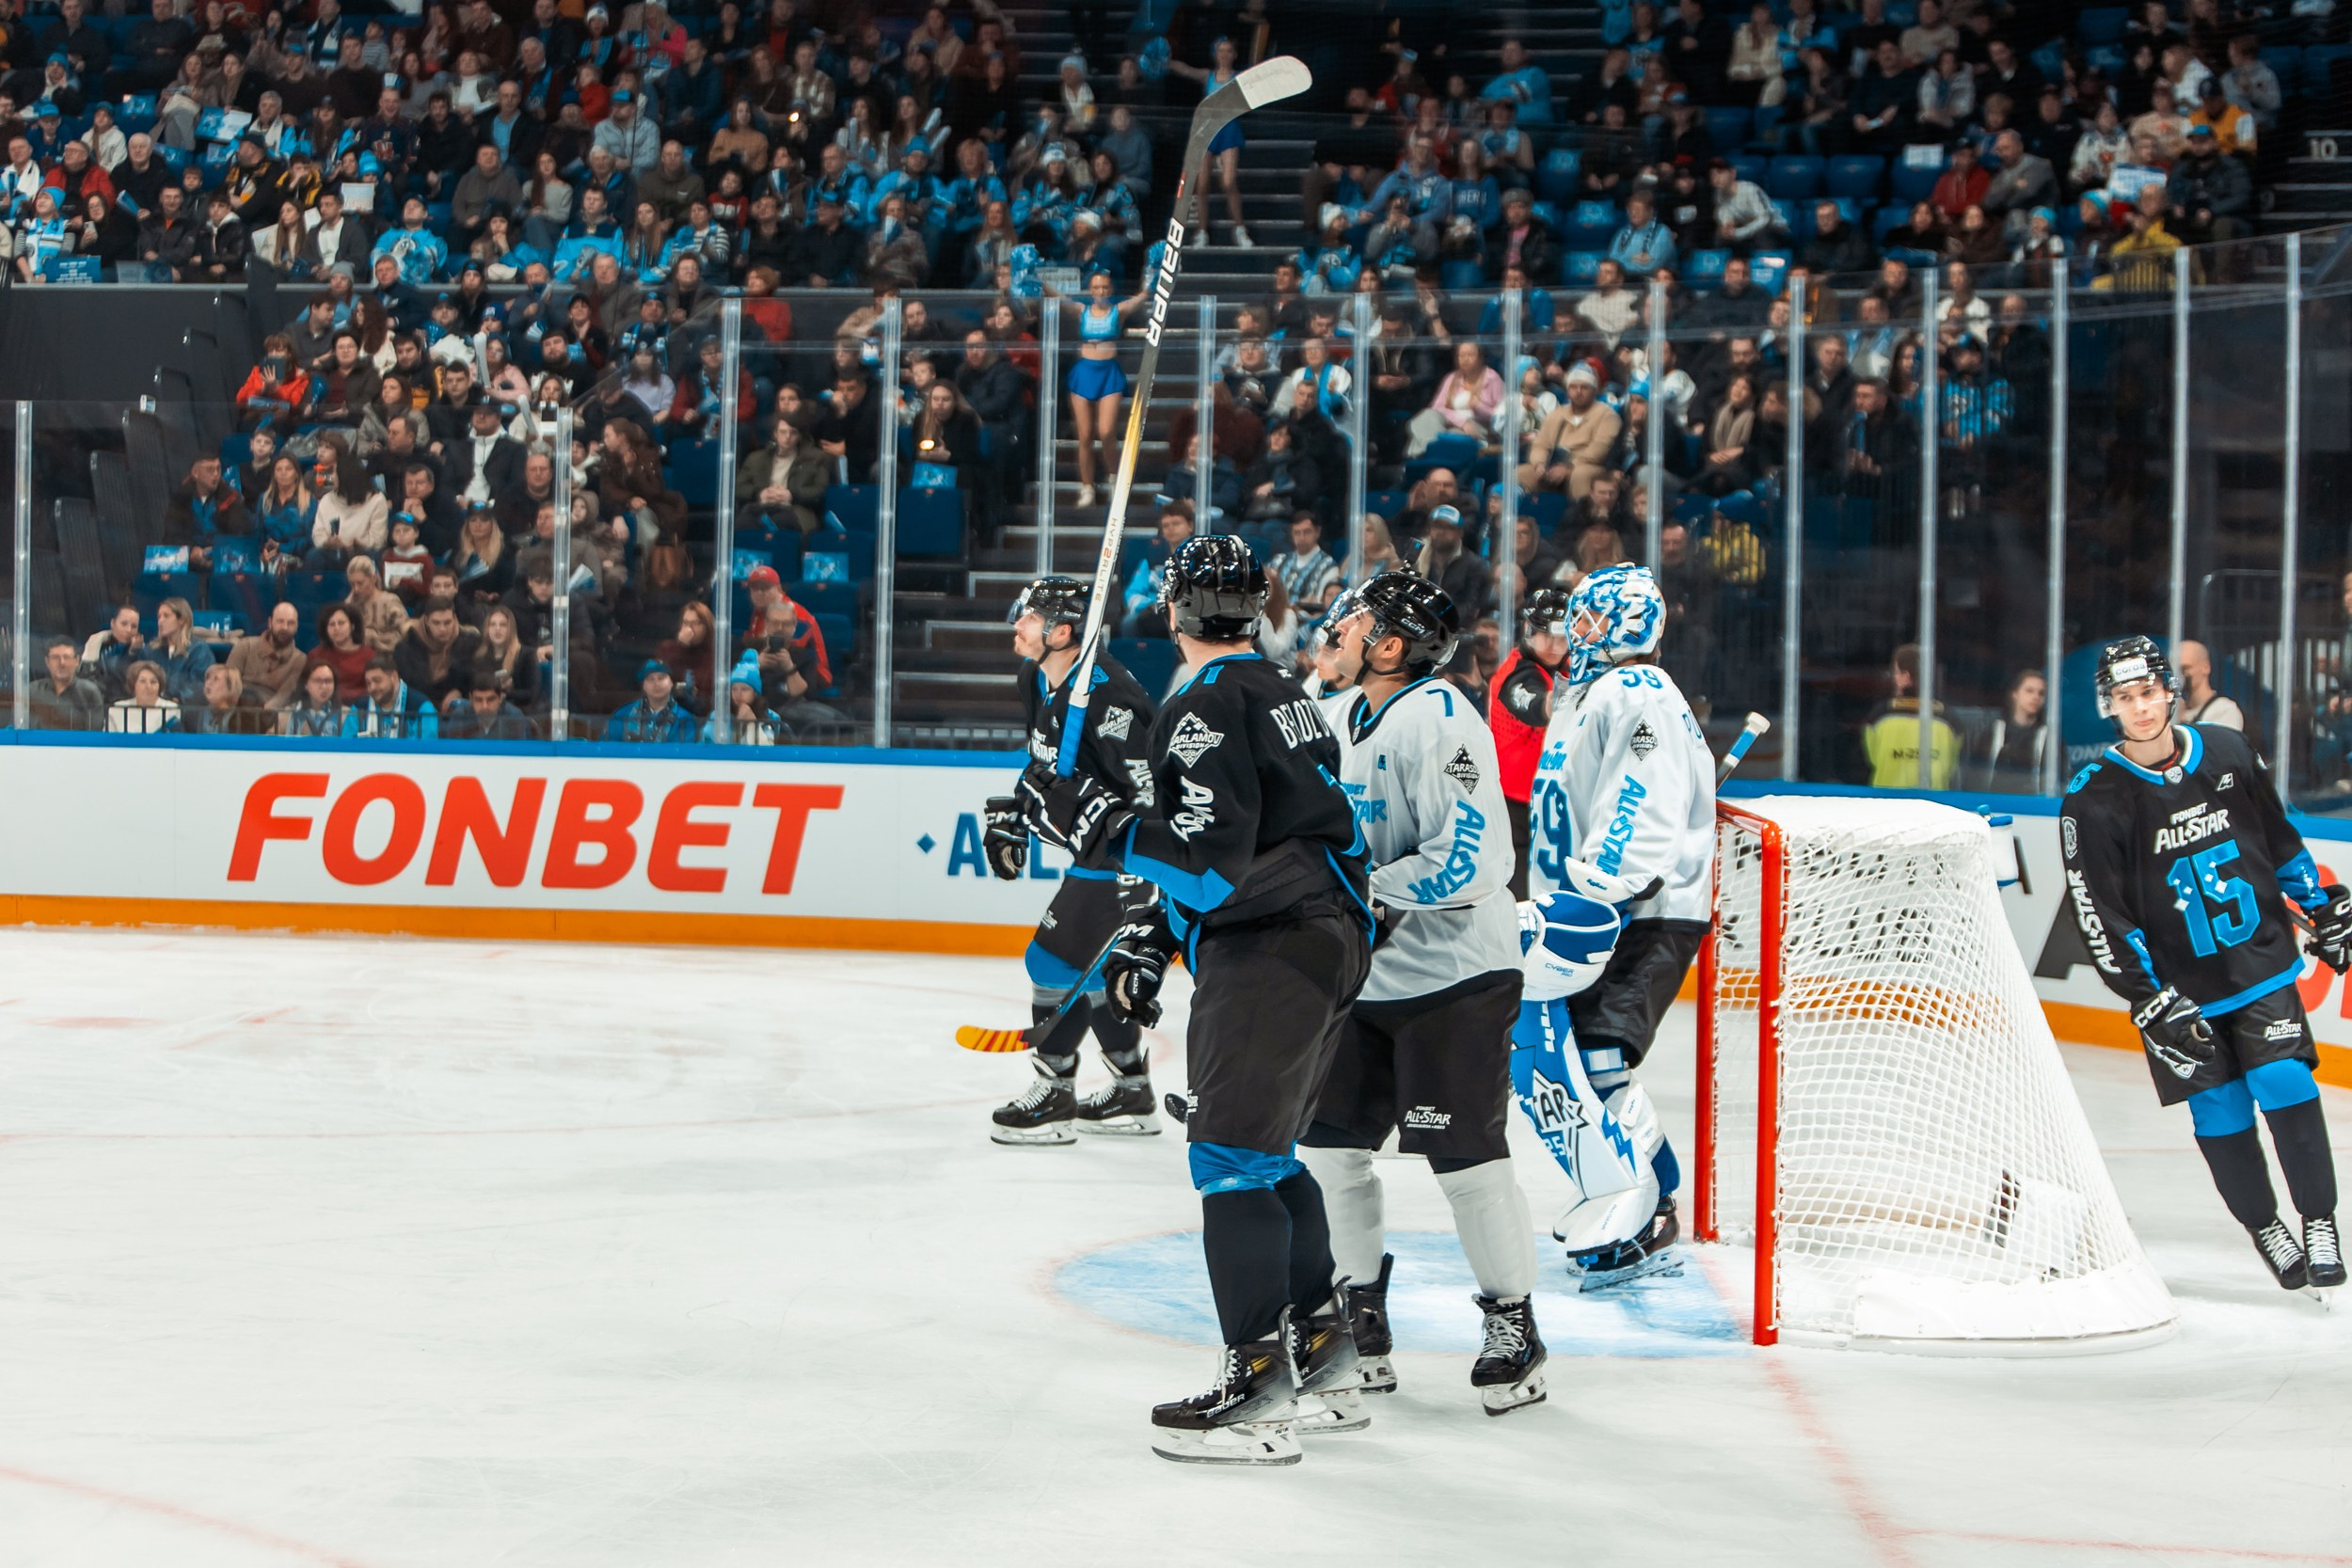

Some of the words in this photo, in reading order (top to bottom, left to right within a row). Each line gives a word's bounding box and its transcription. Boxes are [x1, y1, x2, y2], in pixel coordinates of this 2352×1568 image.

[2310, 137, 2338, 161] 10
[1401, 617, 1426, 634] CCM
[1617, 666, 1662, 689] 59
[1425, 689, 1454, 718] 7
[2169, 802, 2208, 825] FONBET
[227, 772, 845, 895] FONBET
[2167, 838, 2261, 958] 15
[1545, 962, 1574, 974] CYBER
[2133, 985, 2179, 1028] CCM
